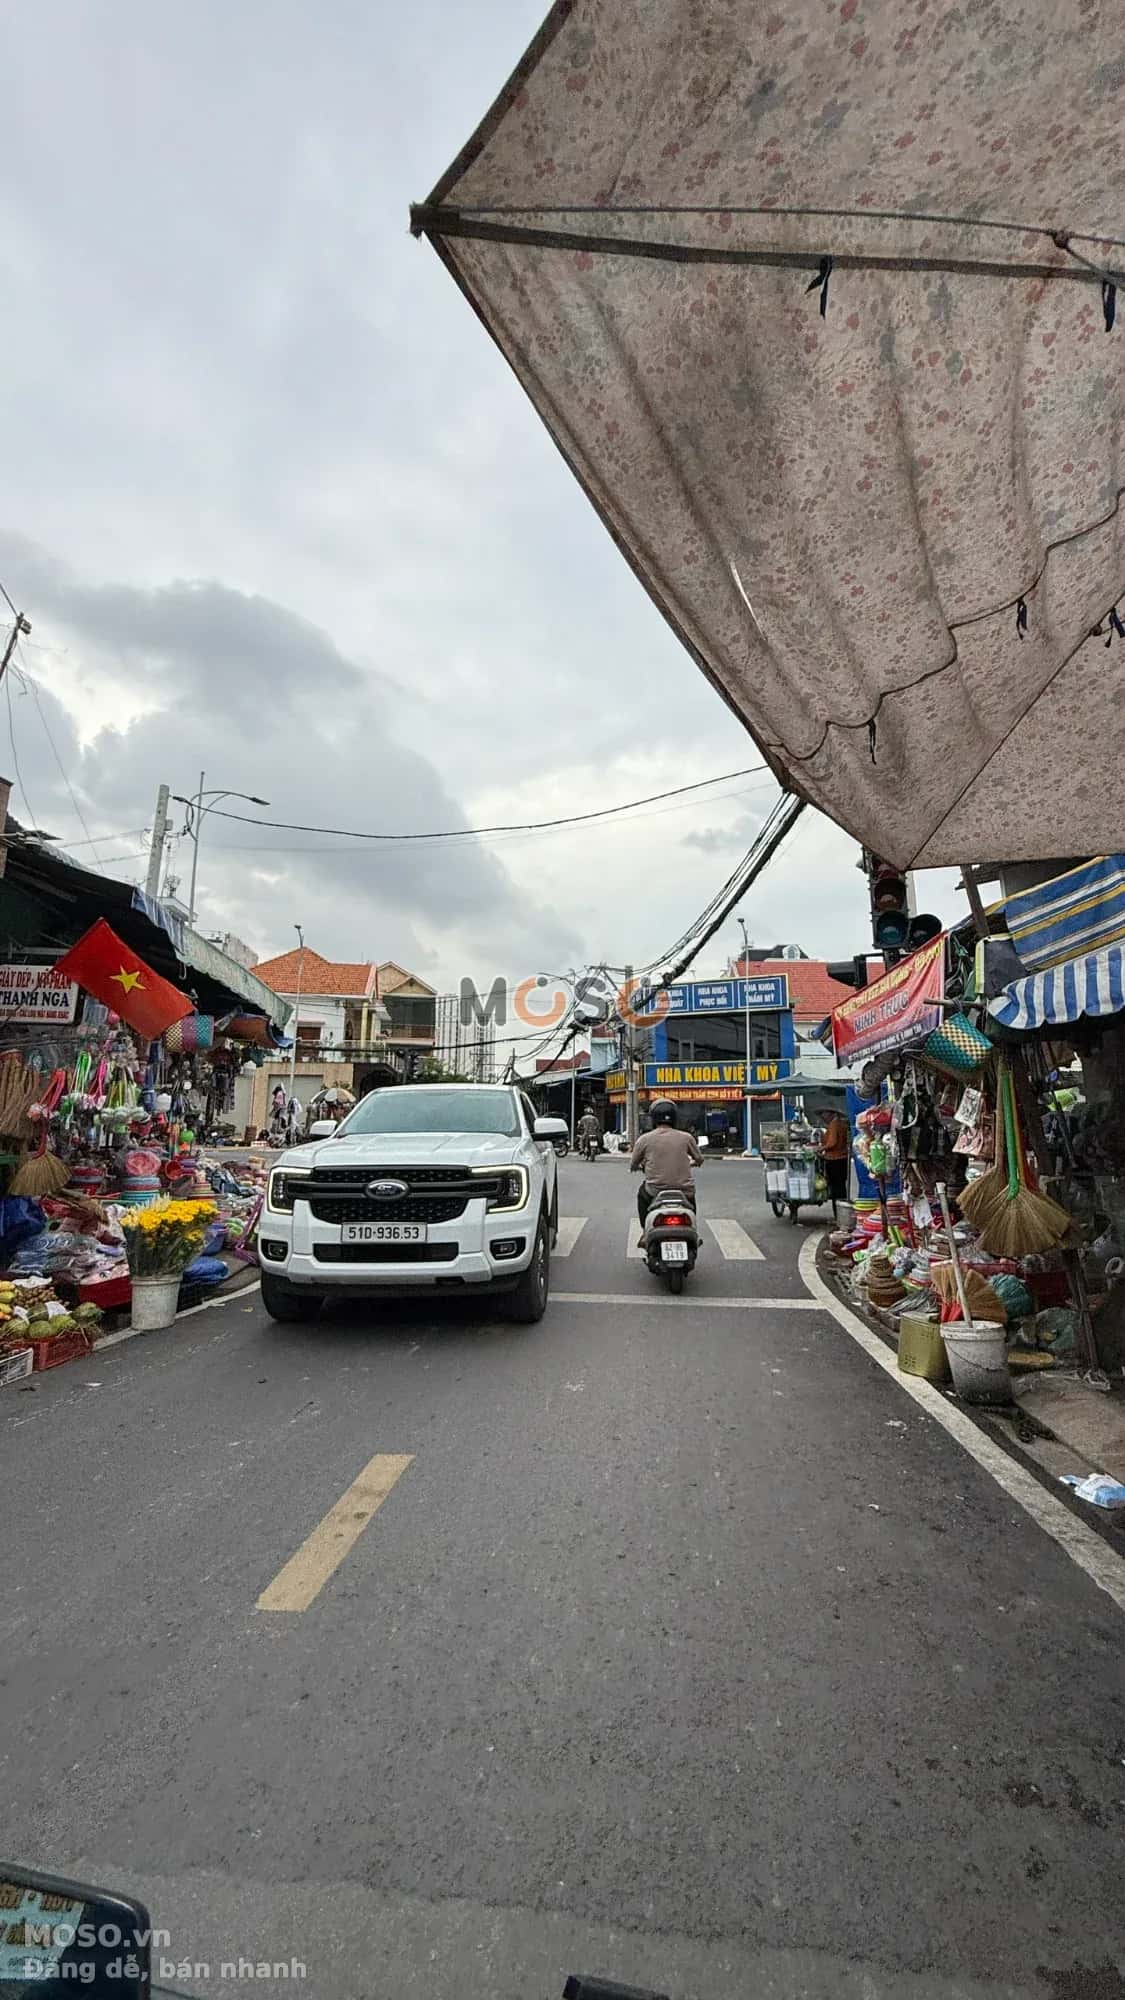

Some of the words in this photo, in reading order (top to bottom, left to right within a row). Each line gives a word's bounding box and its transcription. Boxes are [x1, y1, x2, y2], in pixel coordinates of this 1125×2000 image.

[41, 992, 69, 1007] NGA
[656, 1067, 682, 1083] NHA
[685, 1066, 720, 1082] KHOA
[723, 1063, 752, 1084] VIỆ
[756, 1062, 778, 1081] MỸ
[348, 1226, 420, 1240] 51D-936.53
